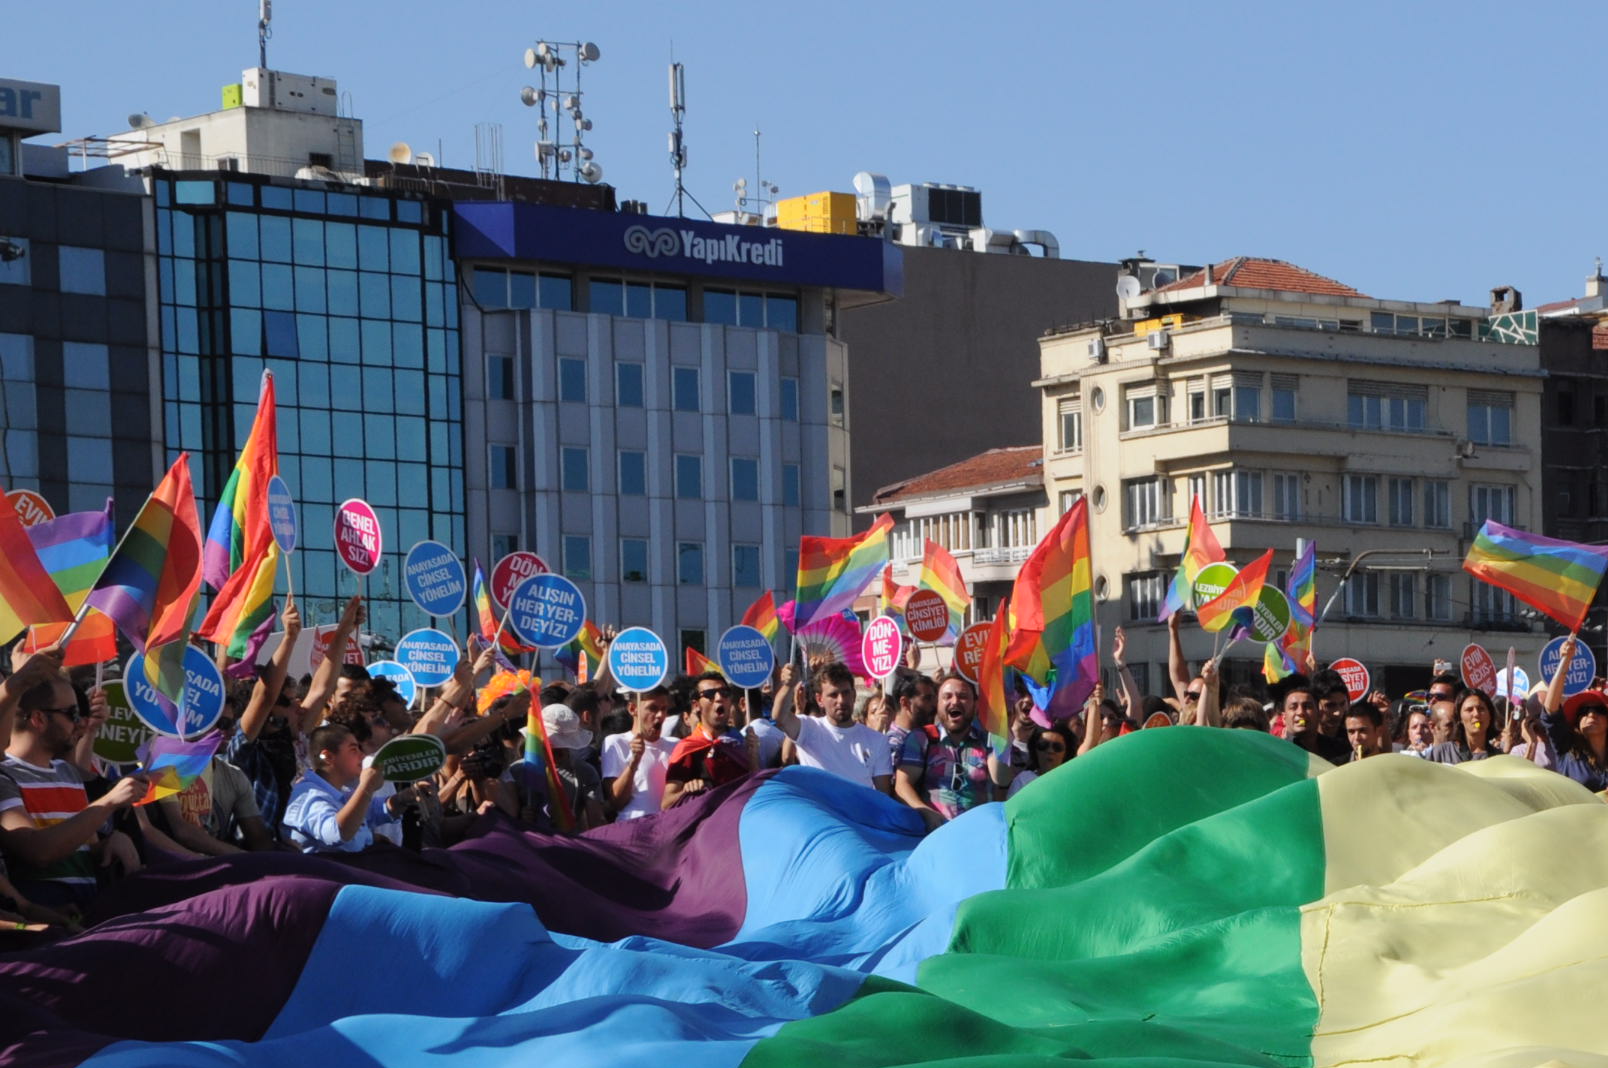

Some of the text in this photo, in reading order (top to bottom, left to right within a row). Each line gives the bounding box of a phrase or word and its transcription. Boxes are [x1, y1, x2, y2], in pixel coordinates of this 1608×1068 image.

[680, 230, 784, 266] YapıKredi
[342, 510, 376, 535] GENEL
[341, 527, 376, 552] AHLAK
[407, 553, 454, 577] ANAYASADA
[418, 567, 452, 588] CİNSEL
[419, 580, 461, 603] YÖNELİM
[528, 584, 574, 606] ALIŞIN
[515, 597, 578, 623] HER YER-
[907, 605, 945, 620] CİNSİYET
[520, 615, 567, 638] DEYİZ!
[870, 621, 896, 640] DÖN-
[401, 641, 454, 652] ANAYASADA
[614, 641, 661, 652] ANAYASADA
[722, 639, 766, 650] ANAYASADA
[873, 639, 893, 656] ME-
[408, 650, 446, 662] CİNSEL
[620, 651, 656, 663] CİNSEL
[729, 649, 761, 661] CİNSEL
[617, 664, 661, 676] YÖNELİM
[728, 661, 769, 674] YÖNELİM
[1543, 661, 1560, 676] HE
[1566, 671, 1587, 684] YİZ!
[385, 757, 441, 775] ARDIR
